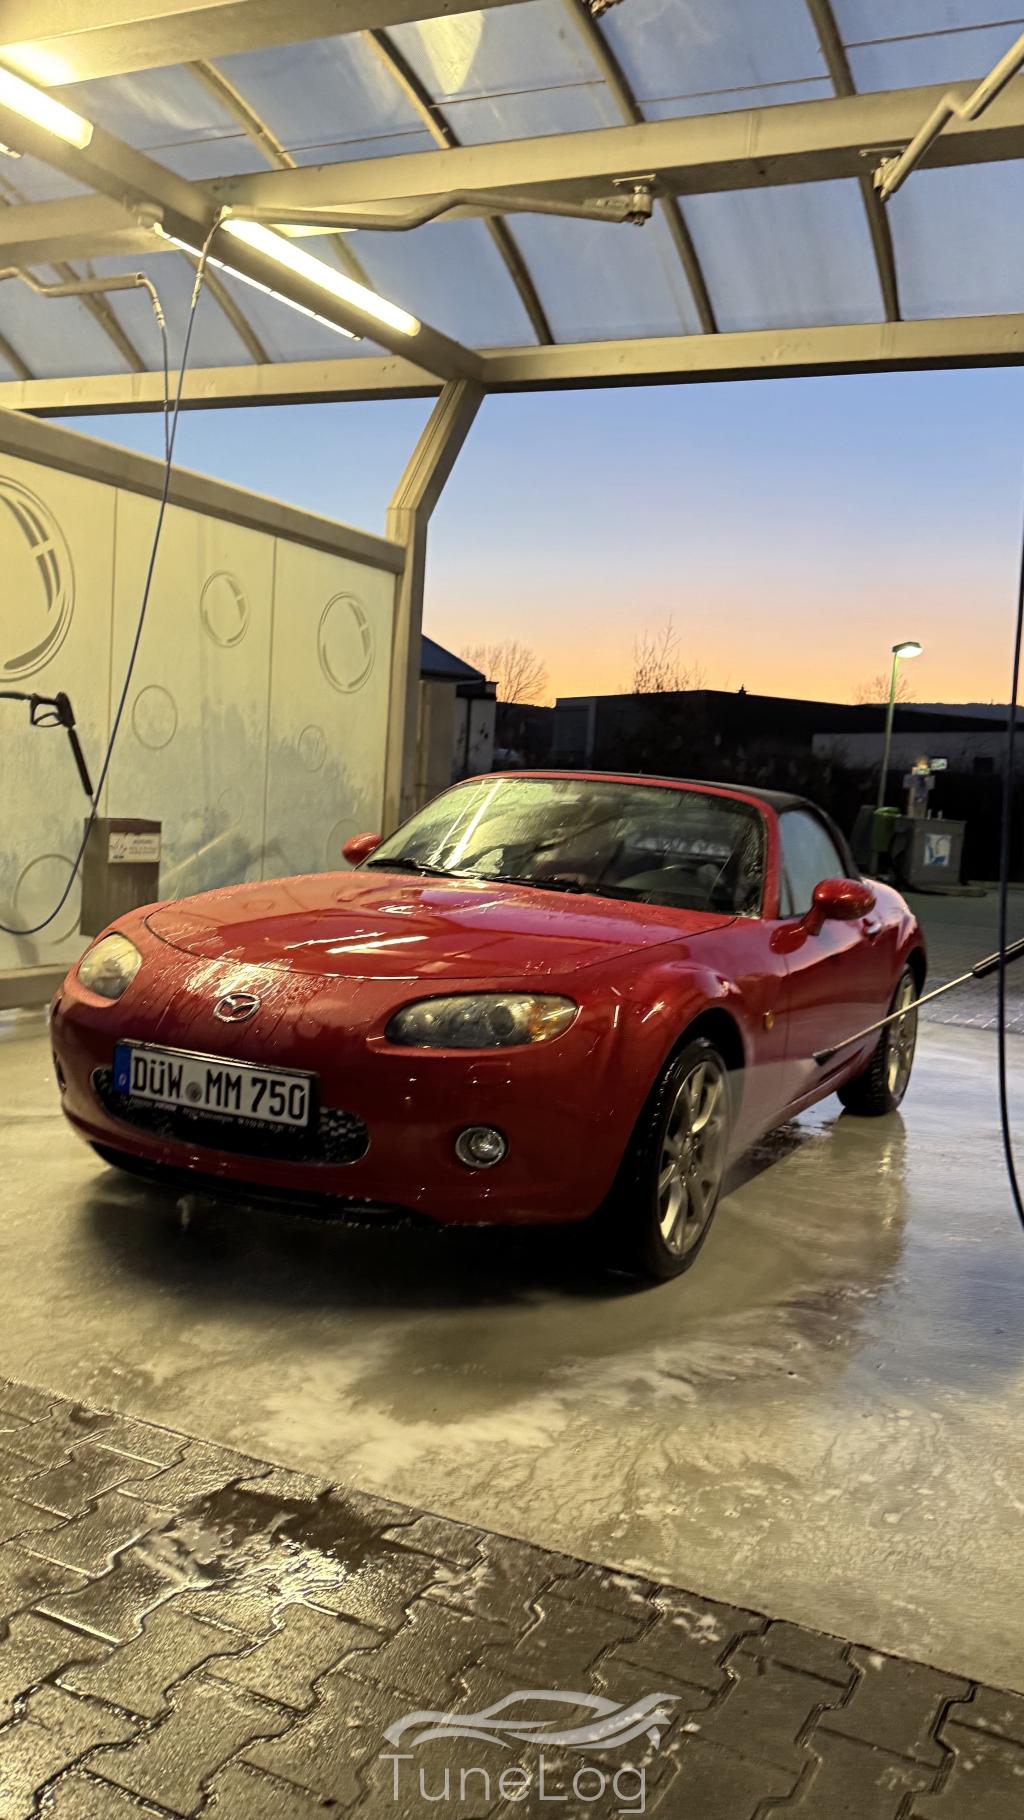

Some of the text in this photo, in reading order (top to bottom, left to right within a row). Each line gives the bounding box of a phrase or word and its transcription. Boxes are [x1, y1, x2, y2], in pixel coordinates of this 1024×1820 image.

[132, 1056, 306, 1120] DÜW MM 750
